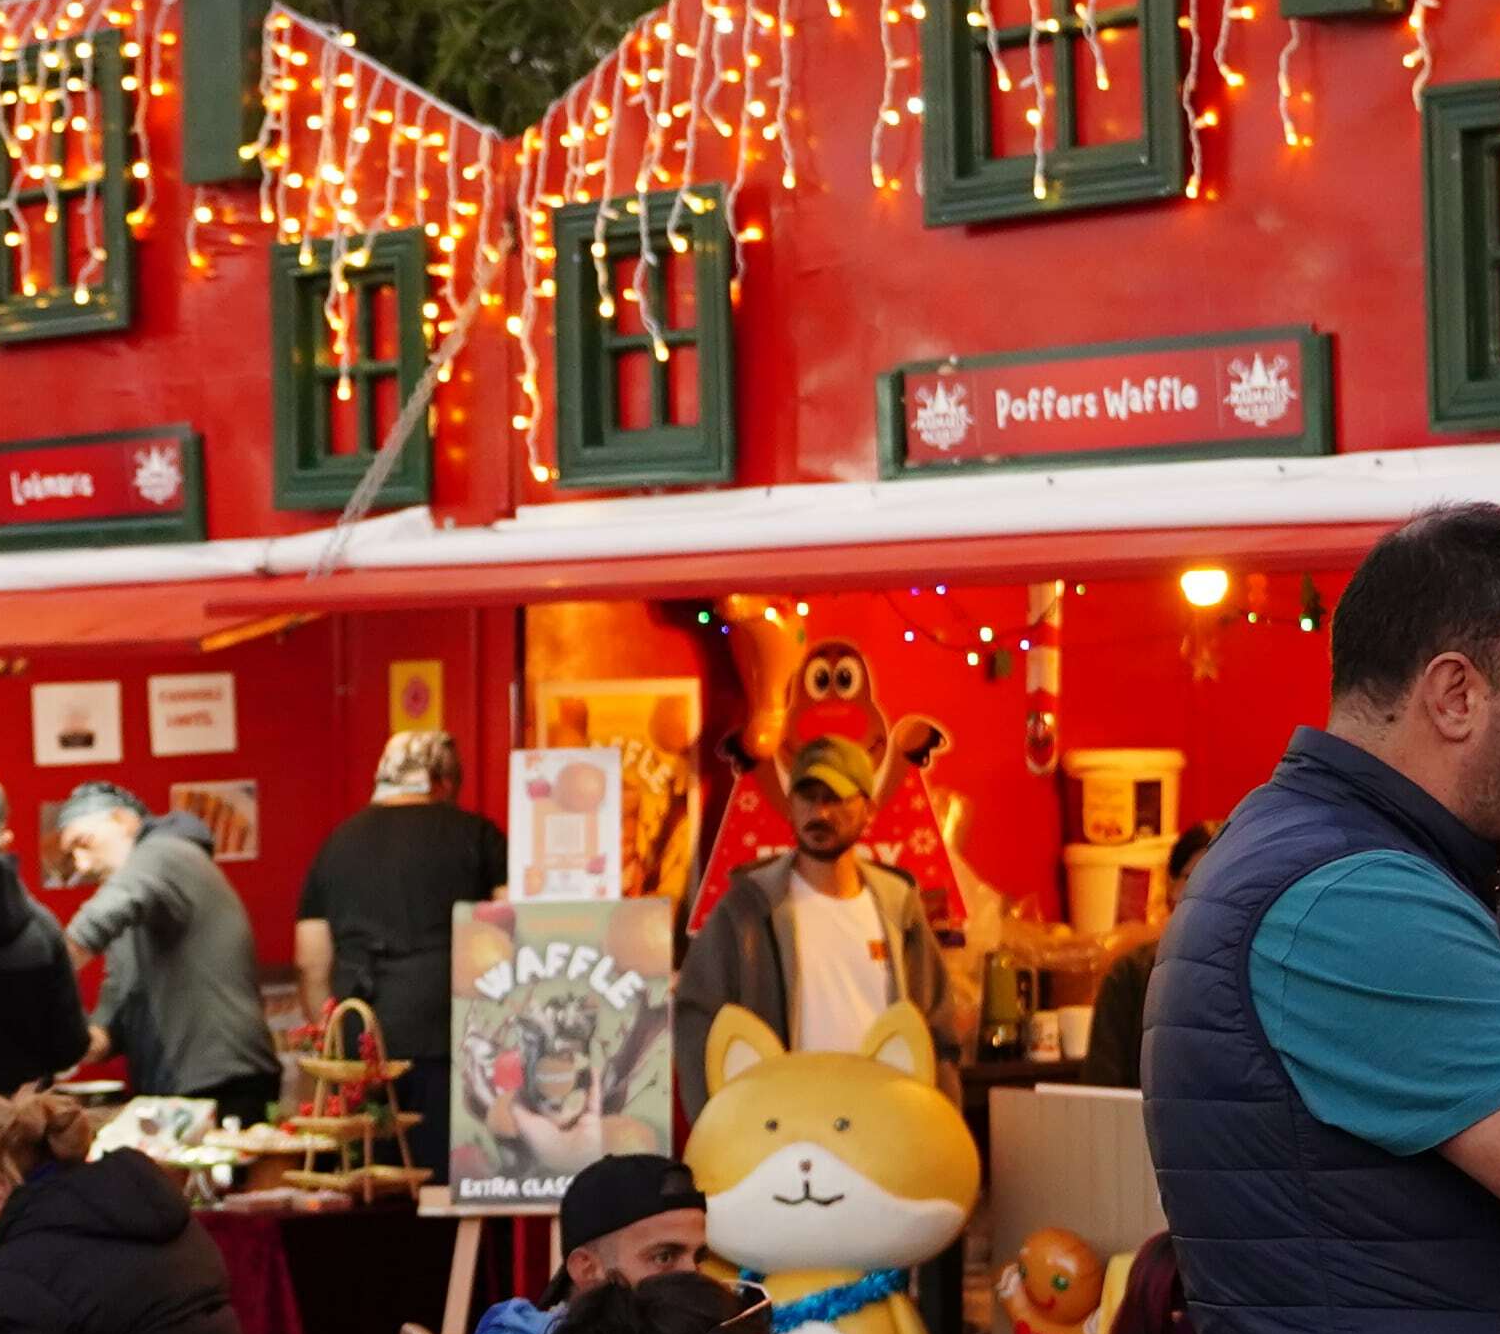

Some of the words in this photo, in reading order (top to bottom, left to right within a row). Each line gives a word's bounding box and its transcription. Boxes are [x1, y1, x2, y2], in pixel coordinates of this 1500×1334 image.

[995, 386, 1098, 430] Poffers
[1103, 375, 1199, 421] Waffle
[474, 941, 645, 1011] WAFFLE
[520, 1174, 577, 1198] CLAS
